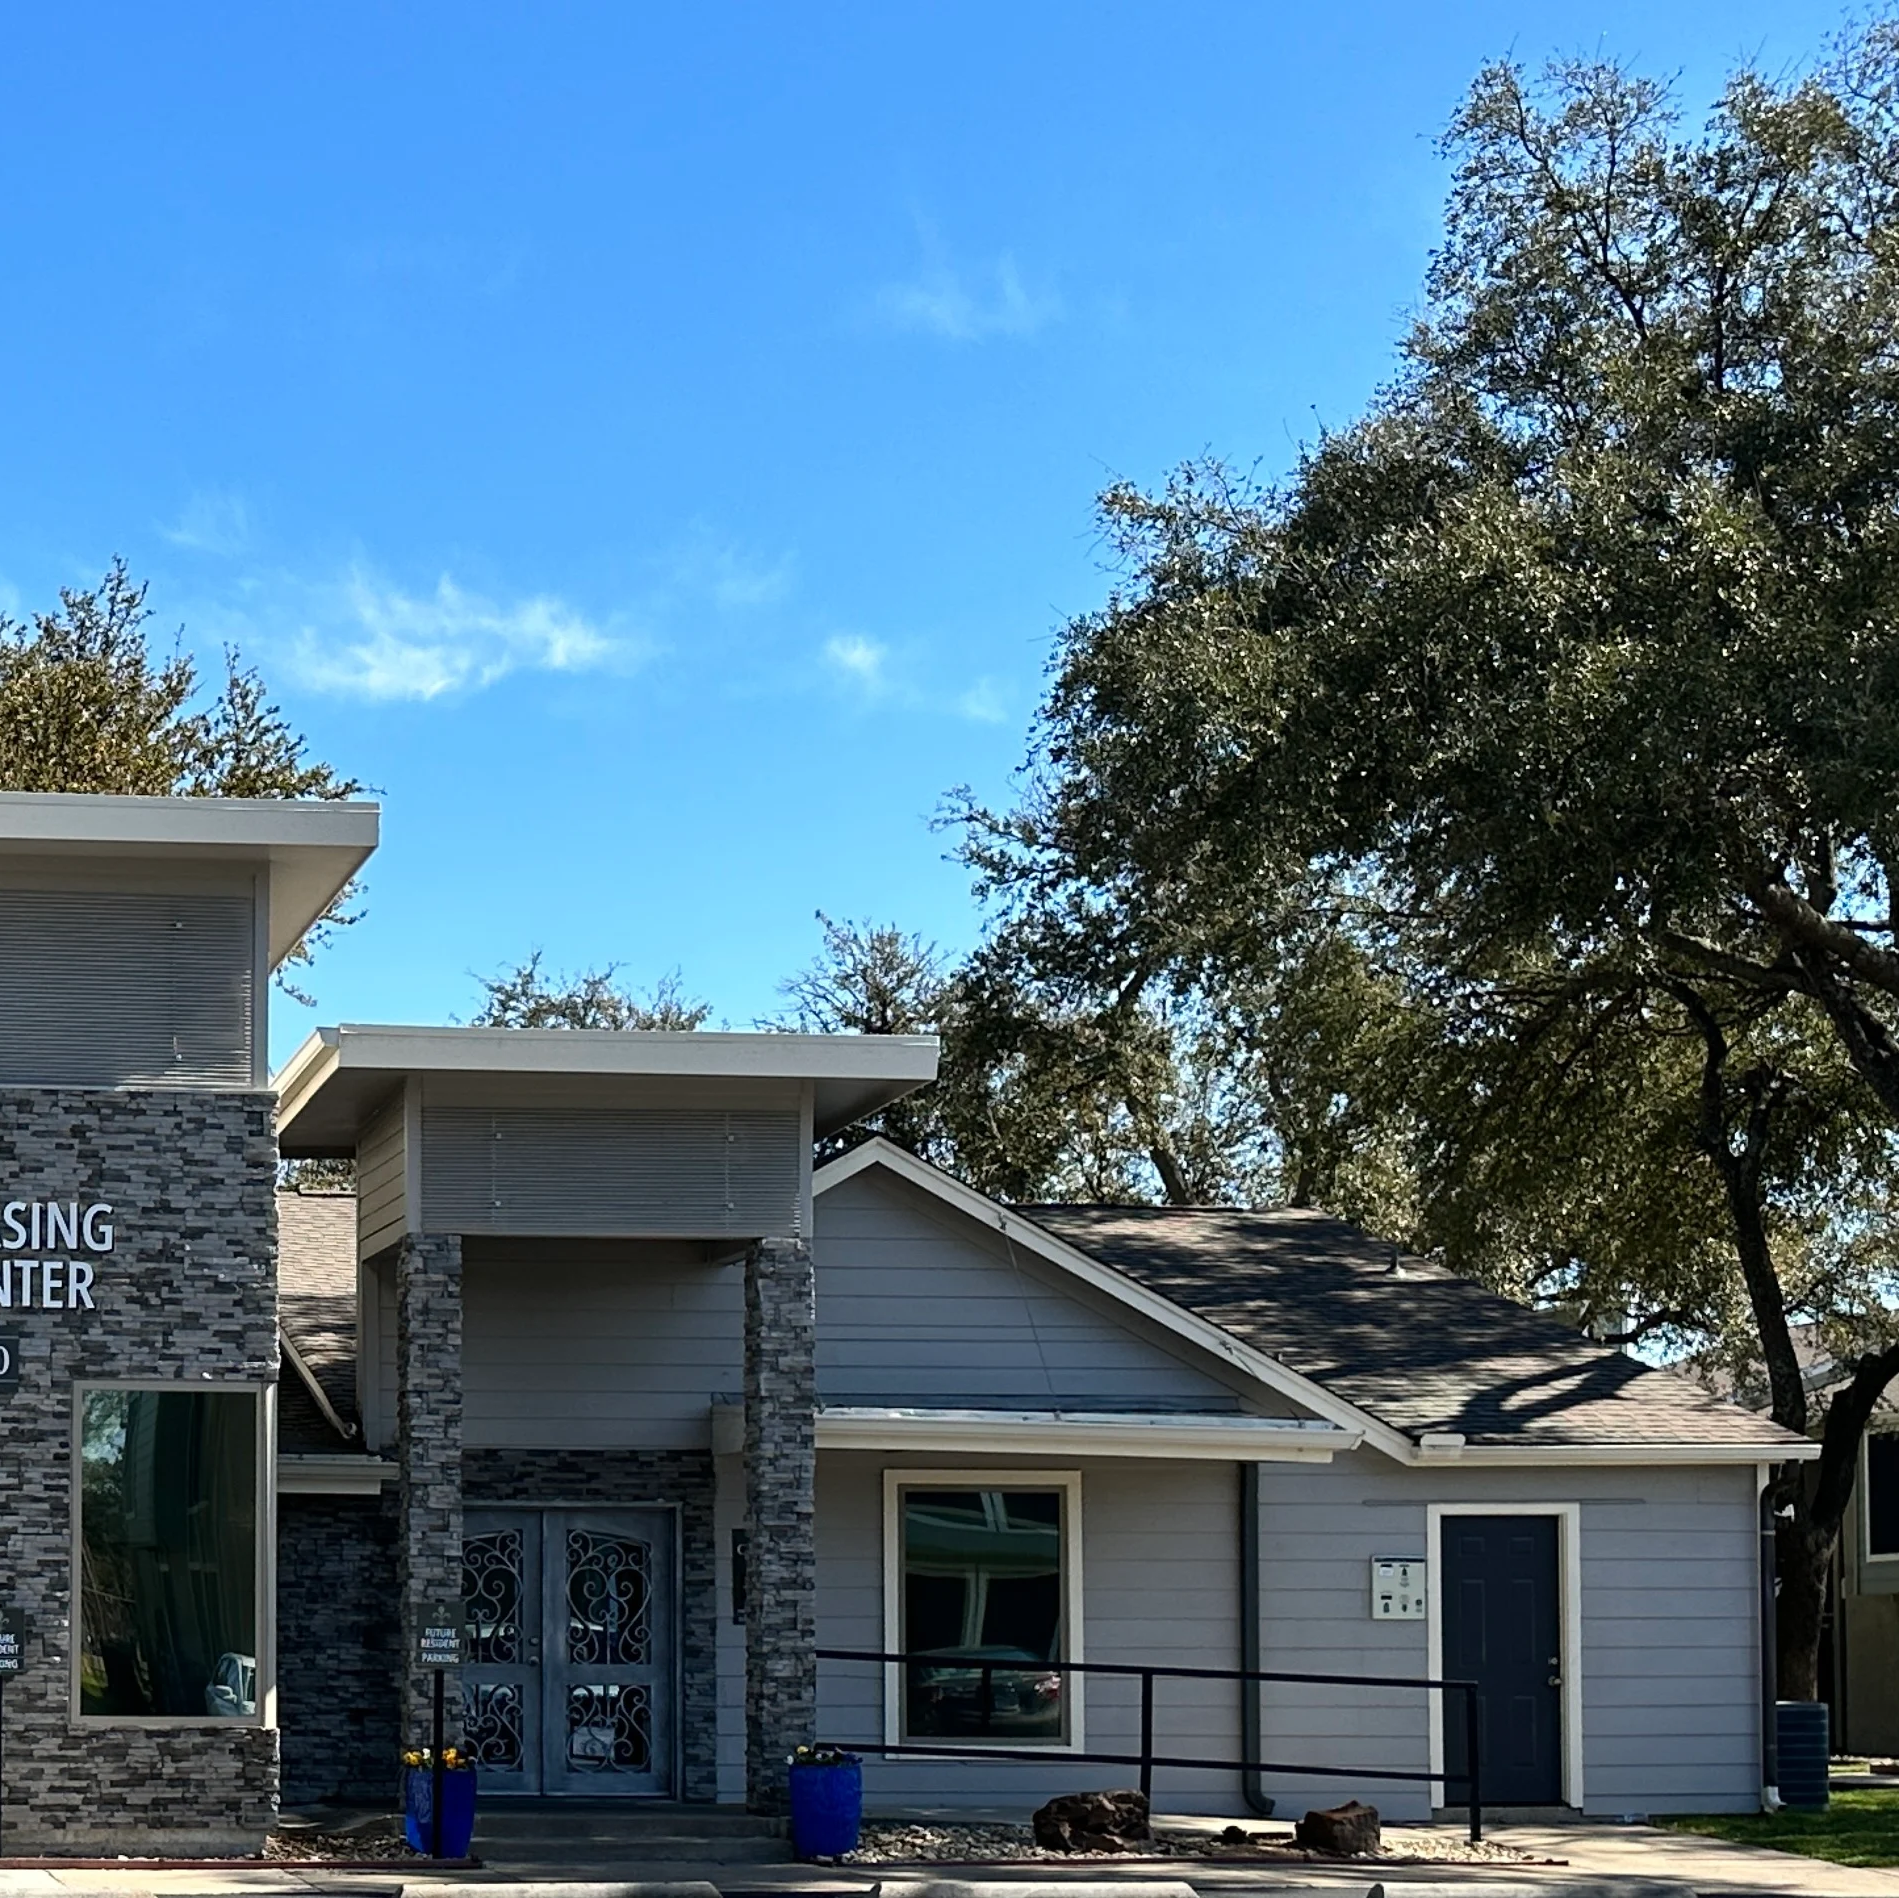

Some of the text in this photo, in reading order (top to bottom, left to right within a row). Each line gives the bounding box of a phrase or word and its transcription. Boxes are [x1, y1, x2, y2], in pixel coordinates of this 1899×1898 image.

[425, 1628, 456, 1638] FUTURE
[421, 1638, 460, 1648] RESIDENT
[422, 1653, 459, 1663] PARKING
